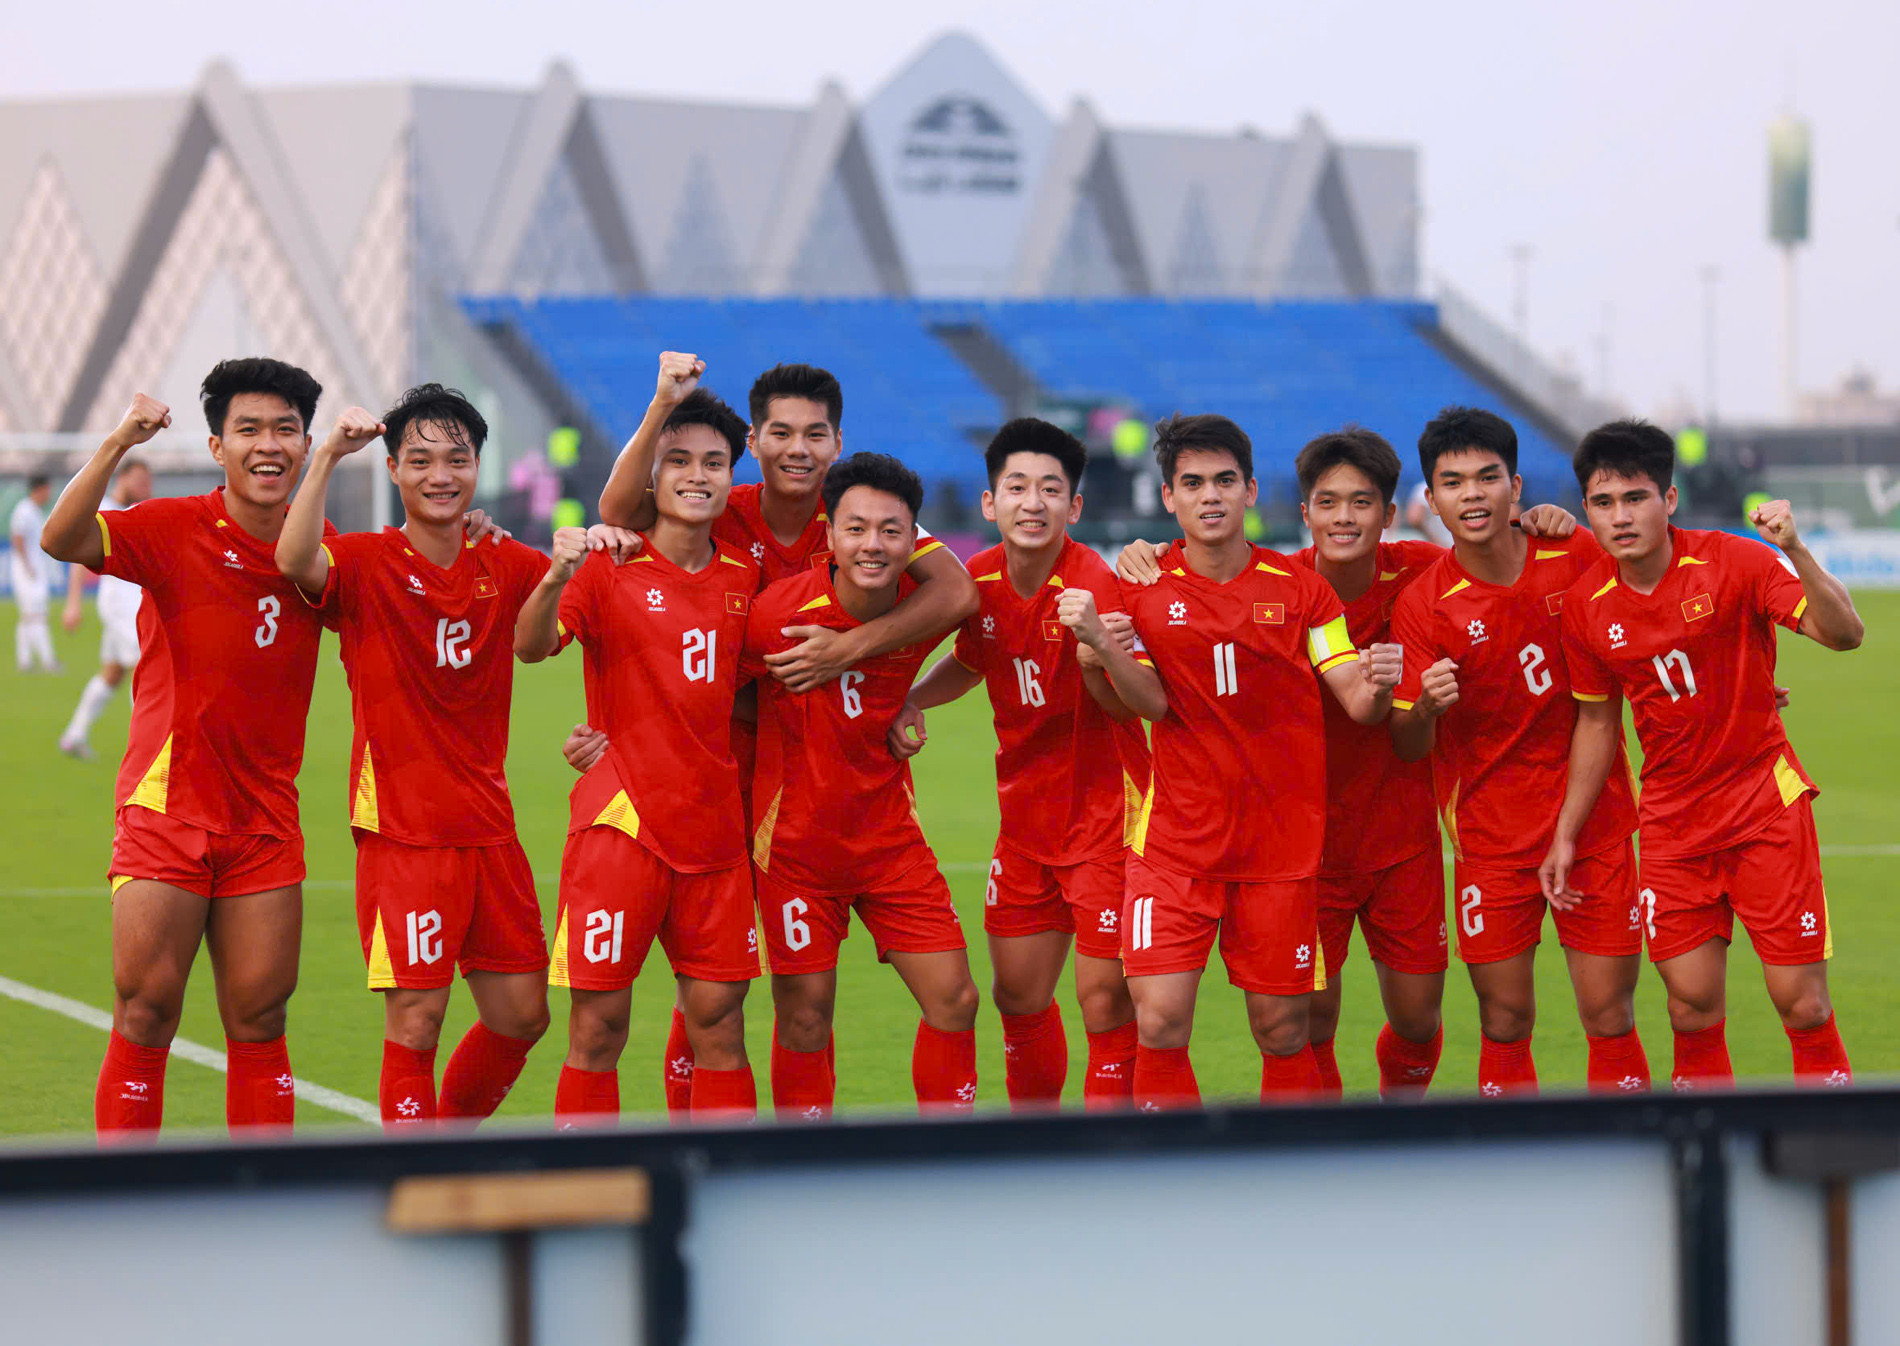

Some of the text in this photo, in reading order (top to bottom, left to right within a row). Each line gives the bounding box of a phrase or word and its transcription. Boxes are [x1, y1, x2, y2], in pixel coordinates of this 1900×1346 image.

[254, 595, 281, 649] 3
[435, 618, 472, 669] 12
[682, 627, 717, 683] 21
[1213, 642, 1238, 696] 11
[1518, 643, 1553, 696] 2
[1652, 648, 1698, 702] 17
[840, 671, 865, 719] 6
[1013, 657, 1046, 708] 16
[406, 909, 443, 966] 12
[583, 909, 625, 964] 21
[782, 897, 811, 952] 6
[1132, 897, 1154, 951] 11
[1461, 884, 1485, 938] 2
